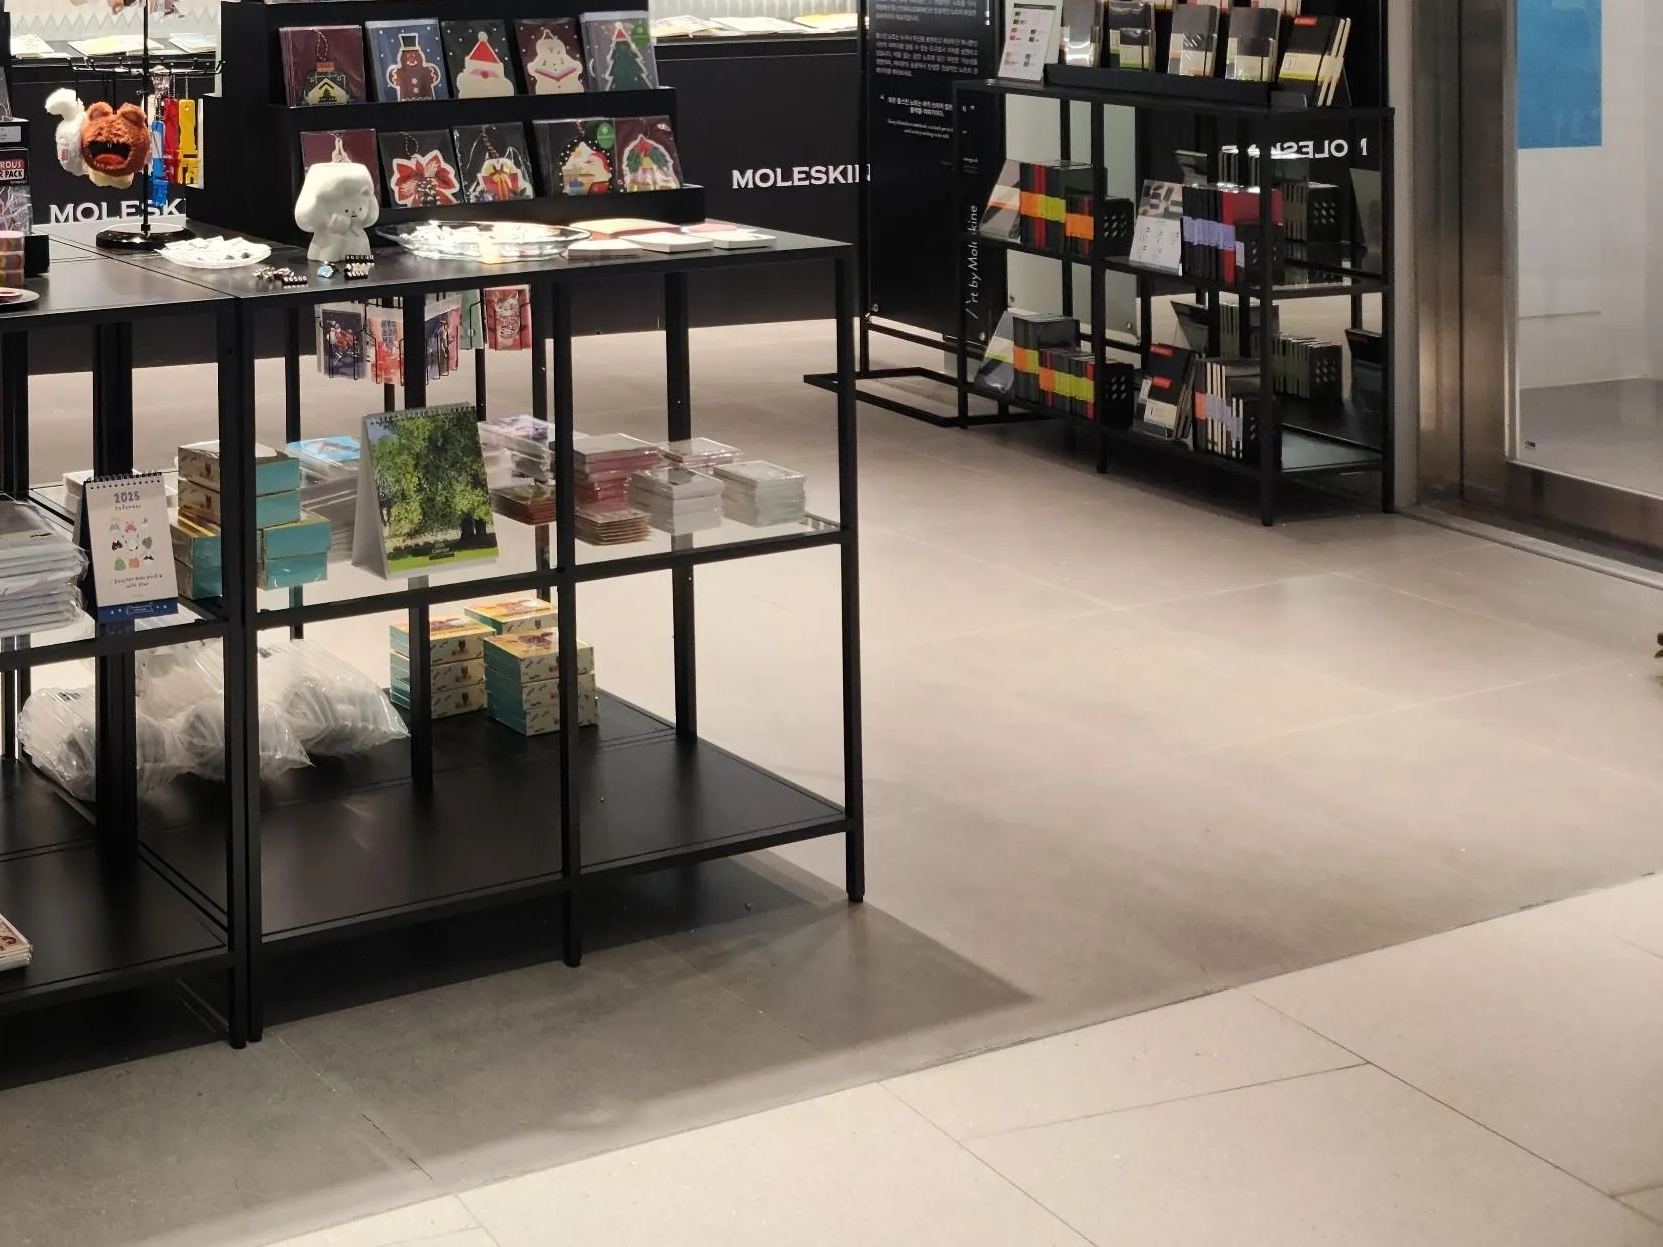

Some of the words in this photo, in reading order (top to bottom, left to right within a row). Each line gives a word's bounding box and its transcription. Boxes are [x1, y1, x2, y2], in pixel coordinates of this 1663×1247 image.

[5, 169, 23, 179] PACK
[50, 198, 186, 224] MOLESK
[968, 205, 979, 274] Molkine
[114, 491, 140, 504] 2025
